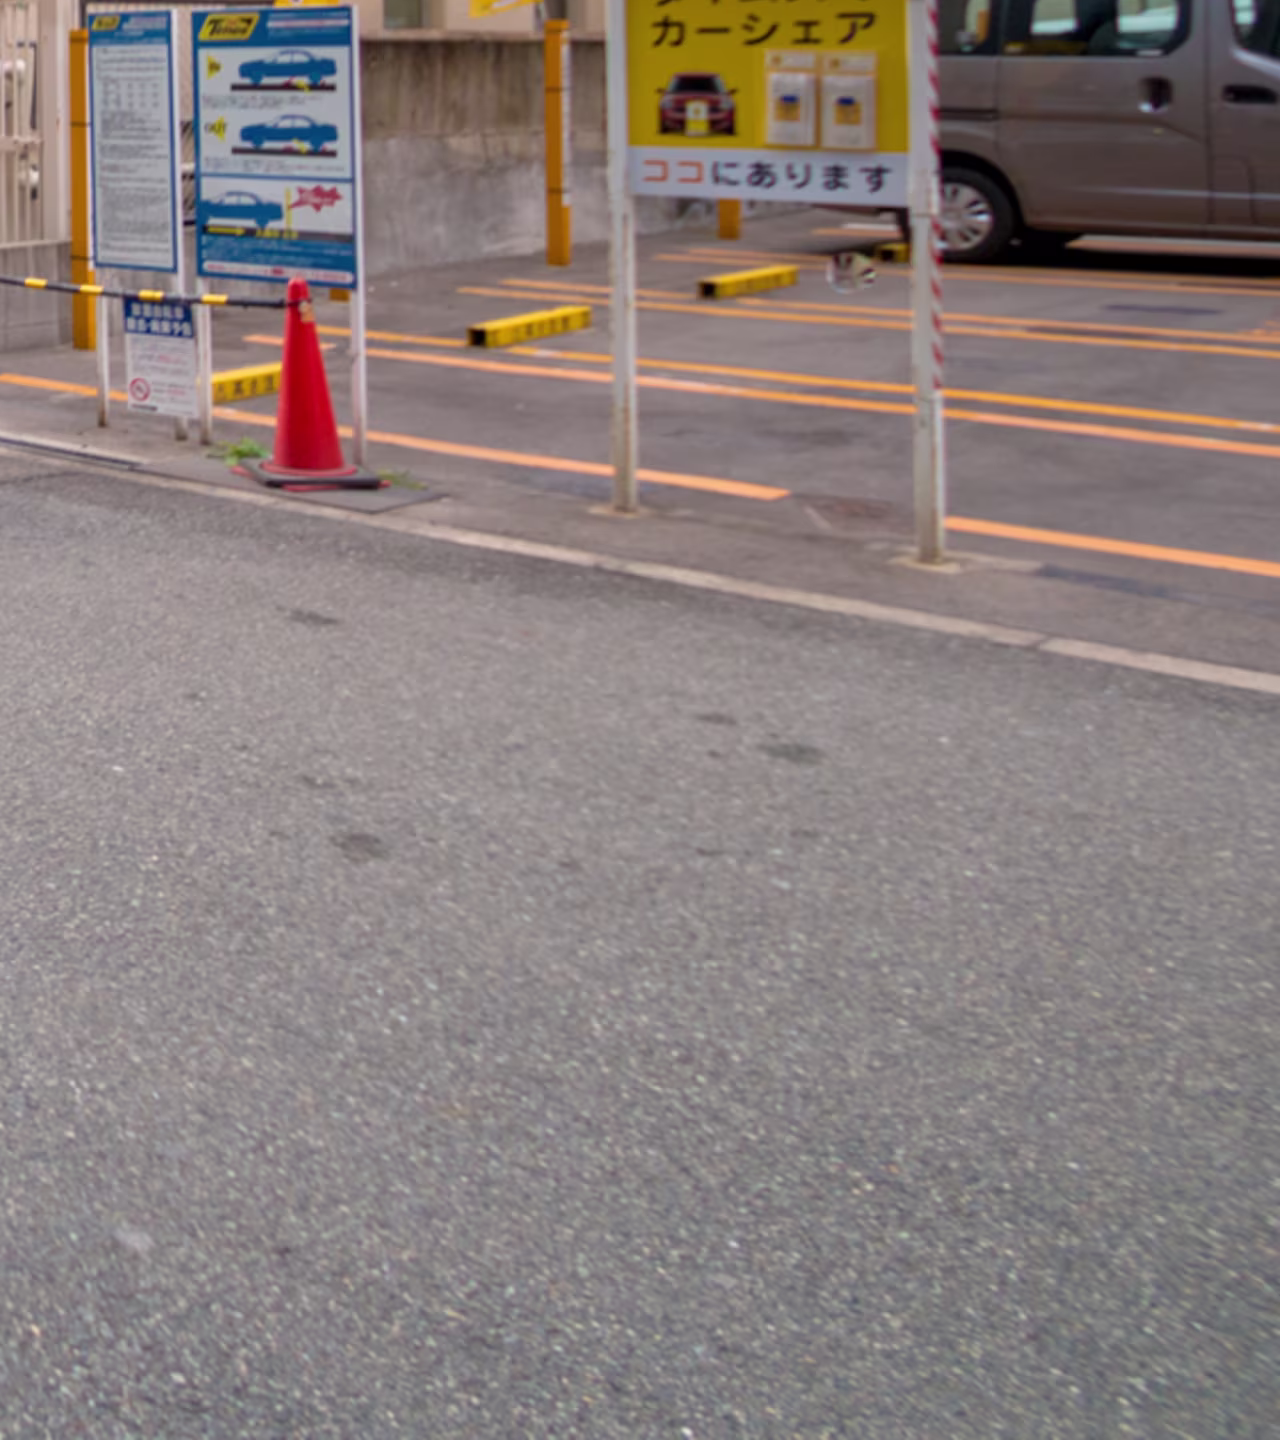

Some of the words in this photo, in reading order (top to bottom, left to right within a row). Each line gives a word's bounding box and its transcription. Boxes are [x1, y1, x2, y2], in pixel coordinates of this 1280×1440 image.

[651, 11, 877, 48] カーシェア
[642, 159, 894, 193] ココにあります
